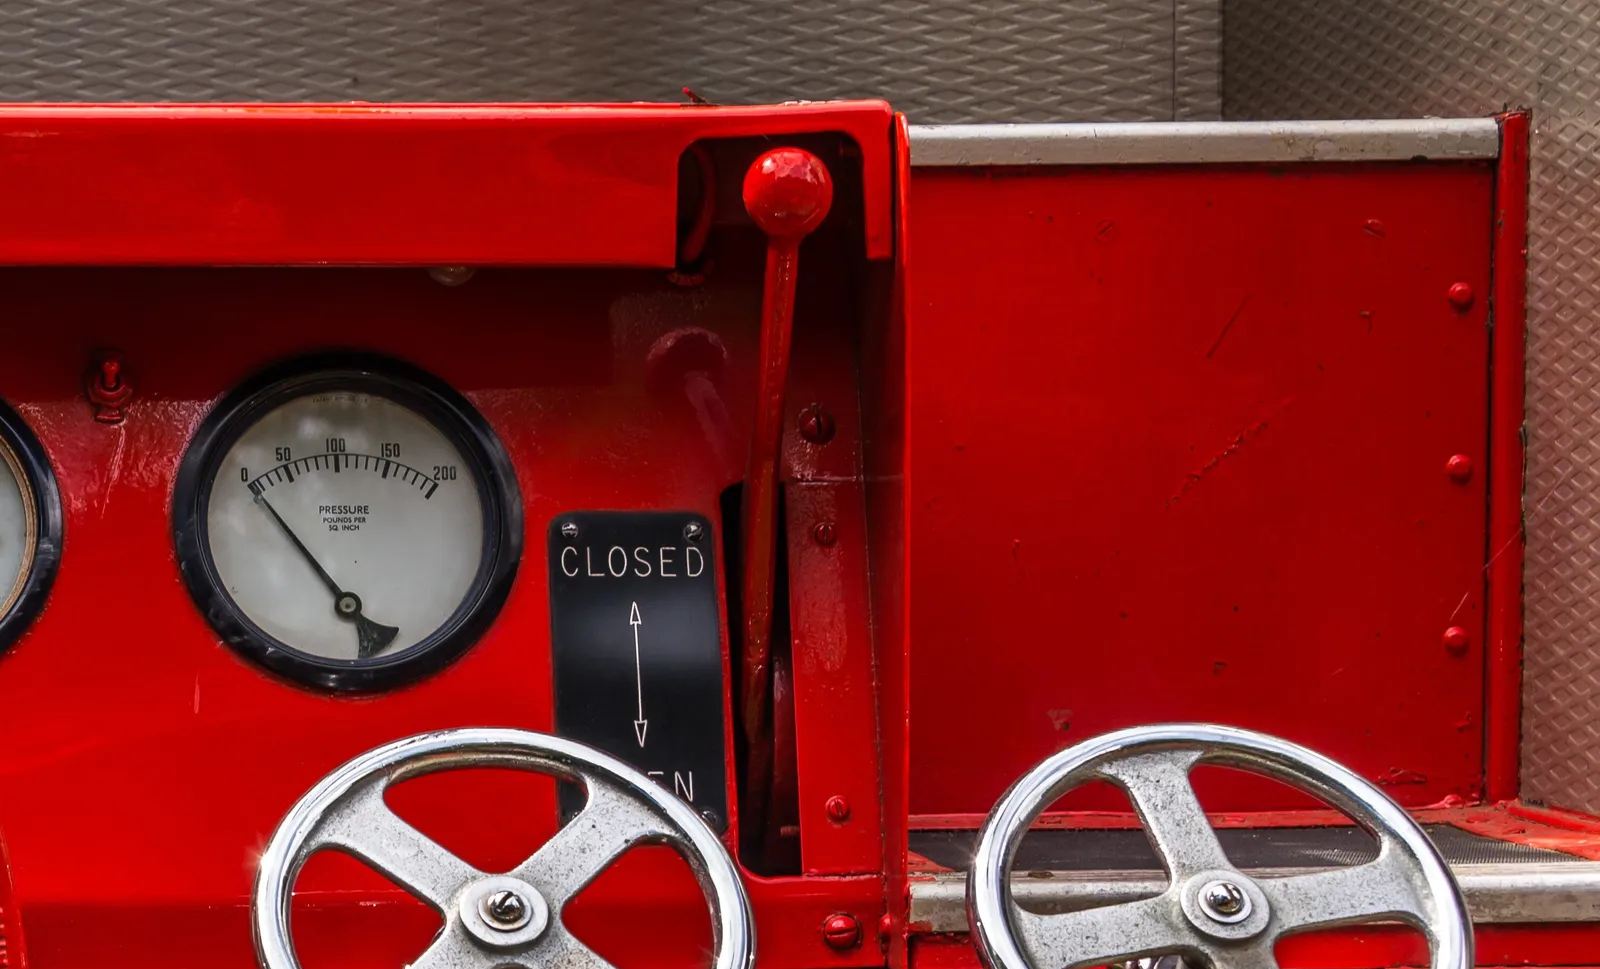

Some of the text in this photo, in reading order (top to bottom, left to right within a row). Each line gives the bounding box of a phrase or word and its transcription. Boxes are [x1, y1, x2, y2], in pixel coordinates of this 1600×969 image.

[326, 438, 346, 453] 100
[381, 443, 400, 458] 150
[275, 447, 291, 462] 50
[241, 467, 248, 482] 0
[433, 466, 456, 481] 200
[319, 505, 369, 515] PRESSURE
[561, 546, 704, 577] CLOSED
